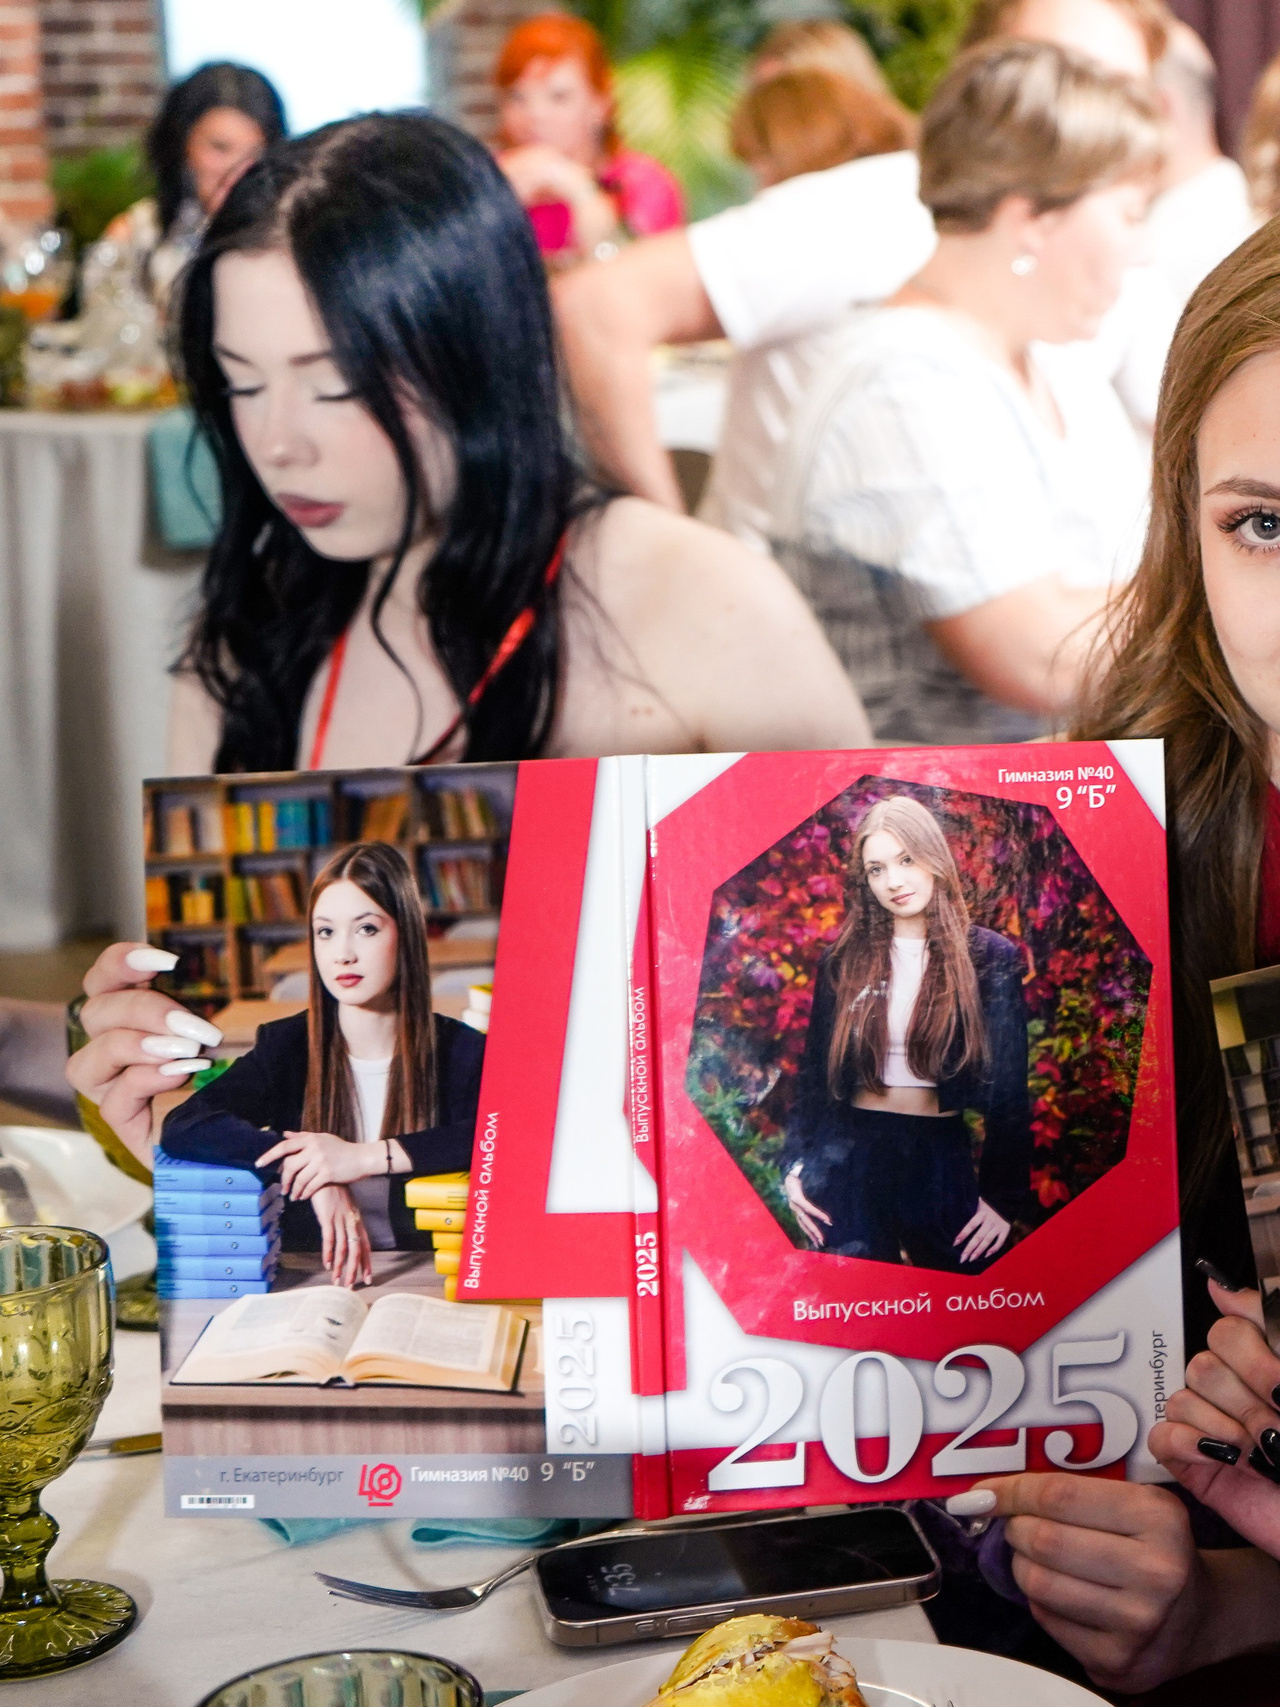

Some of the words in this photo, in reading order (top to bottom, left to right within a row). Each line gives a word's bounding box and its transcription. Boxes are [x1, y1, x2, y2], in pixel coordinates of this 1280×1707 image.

[998, 768, 1074, 783] Гимназия
[1078, 766, 1114, 780] №40
[1056, 786, 1073, 809] 9
[634, 987, 645, 1051] альбом
[631, 1054, 652, 1143] Выпускной
[464, 1189, 490, 1288] Выпускной
[479, 1112, 499, 1185] альбом
[635, 1231, 658, 1297] 2025
[793, 1292, 931, 1323] Выпускной
[946, 1288, 1045, 1312] альбом
[555, 1309, 598, 1447] 2025
[1149, 1330, 1168, 1421] теринбург
[708, 1331, 1139, 1491] 2025
[233, 1467, 344, 1486] Екатеринбург
[410, 1467, 488, 1483] Гимназия
[491, 1466, 529, 1482] №40
[540, 1463, 555, 1482] 9
[601, 1563, 641, 1596] 7:35
